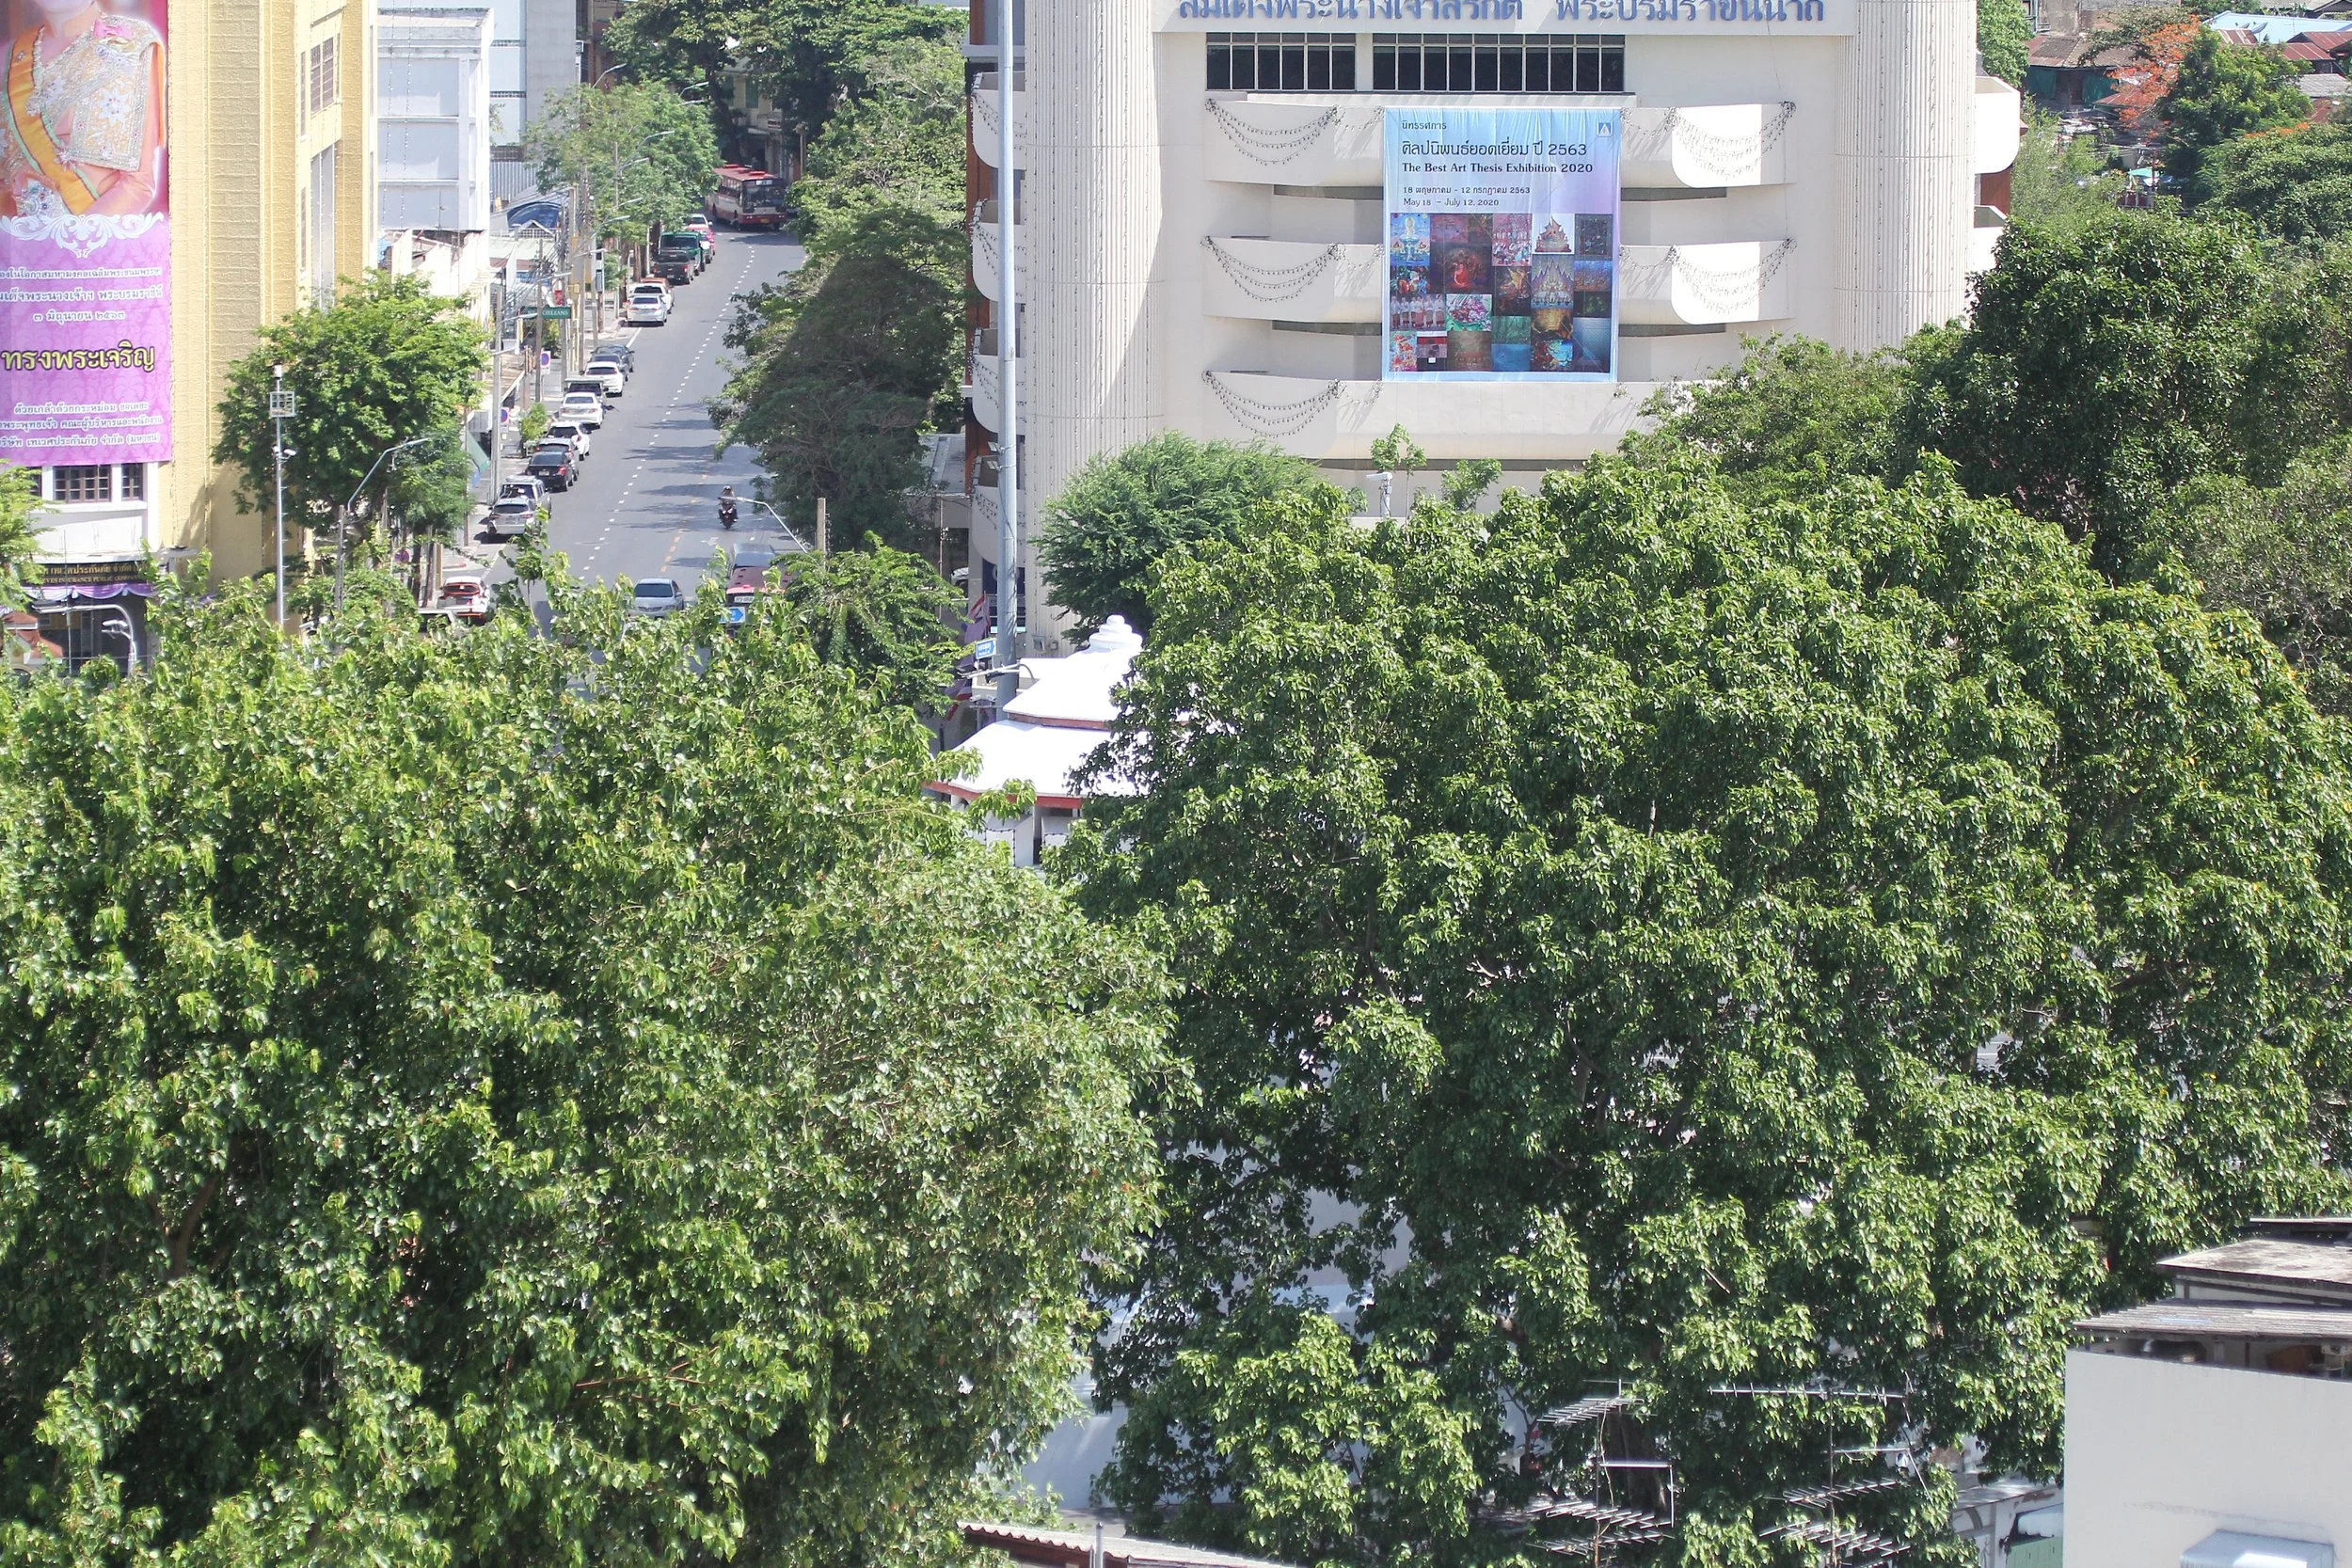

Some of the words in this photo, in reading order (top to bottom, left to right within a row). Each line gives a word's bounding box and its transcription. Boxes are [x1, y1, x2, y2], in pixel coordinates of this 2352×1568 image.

[1402, 119, 1447, 130] นิทรรศการ
[1402, 136, 1529, 155] ศิลปนิพนธ์ยอดเยี่ยม
[1533, 140, 1543, 155] ปี
[1548, 143, 1587, 155] 2563
[1402, 163, 1421, 172] The
[1424, 163, 1446, 172] Best
[1450, 163, 1467, 172] Art
[1470, 163, 1502, 172] Thesis
[1506, 163, 1557, 173] Exhibition
[1561, 163, 1593, 173] 2020
[1416, 186, 1452, 196] พฤษภาคม
[1473, 186, 1507, 196] กรกฎาคม
[1403, 198, 1420, 207] May
[1444, 198, 1461, 207] July
[46, 309, 92, 324] มิถุนายน
[1, 340, 155, 372] ทรงพระเจริญ
